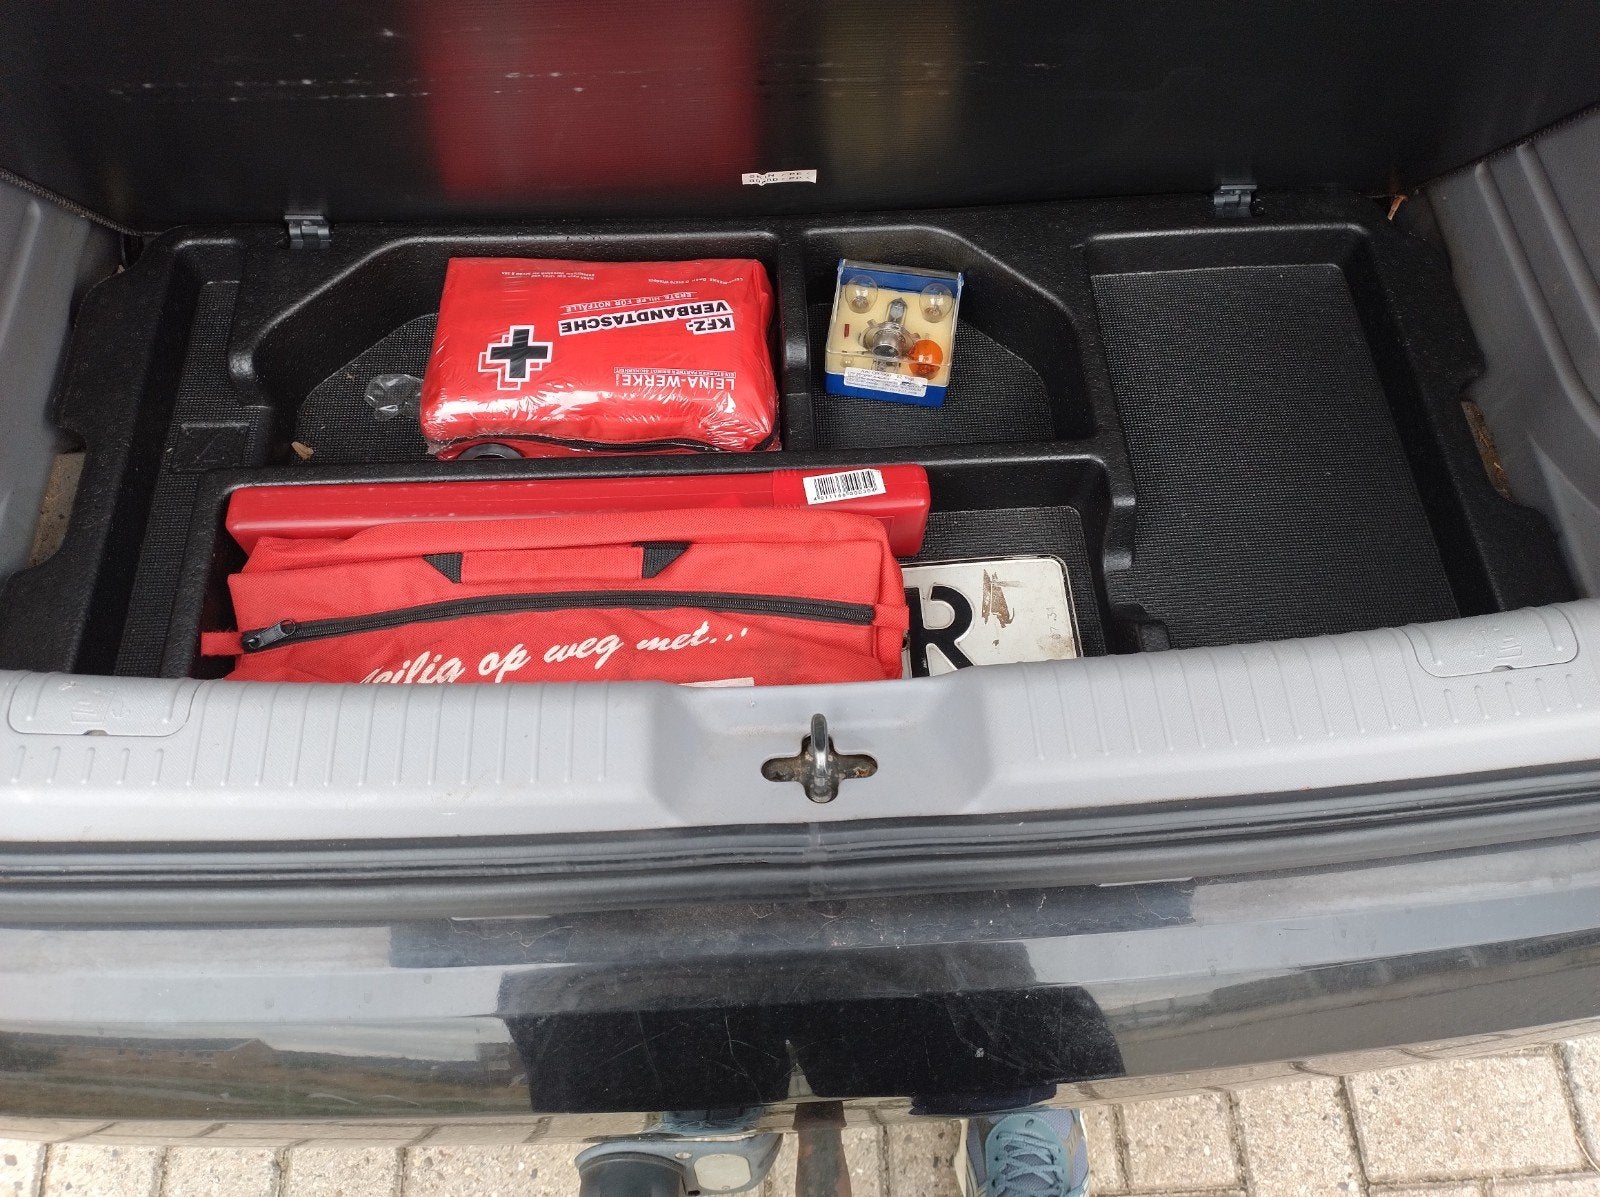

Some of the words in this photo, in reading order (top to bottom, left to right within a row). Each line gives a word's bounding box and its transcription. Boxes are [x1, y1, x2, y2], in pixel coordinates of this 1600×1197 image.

[566, 300, 611, 313] NOTFÄLLE
[614, 298, 632, 307] FÜR
[561, 301, 729, 334] VERBANDTASCHE
[688, 316, 732, 333] KFZ-
[621, 374, 735, 390] LEINA-WERKE
[904, 585, 974, 678] R
[478, 643, 532, 683] op
[543, 633, 624, 670] weg
